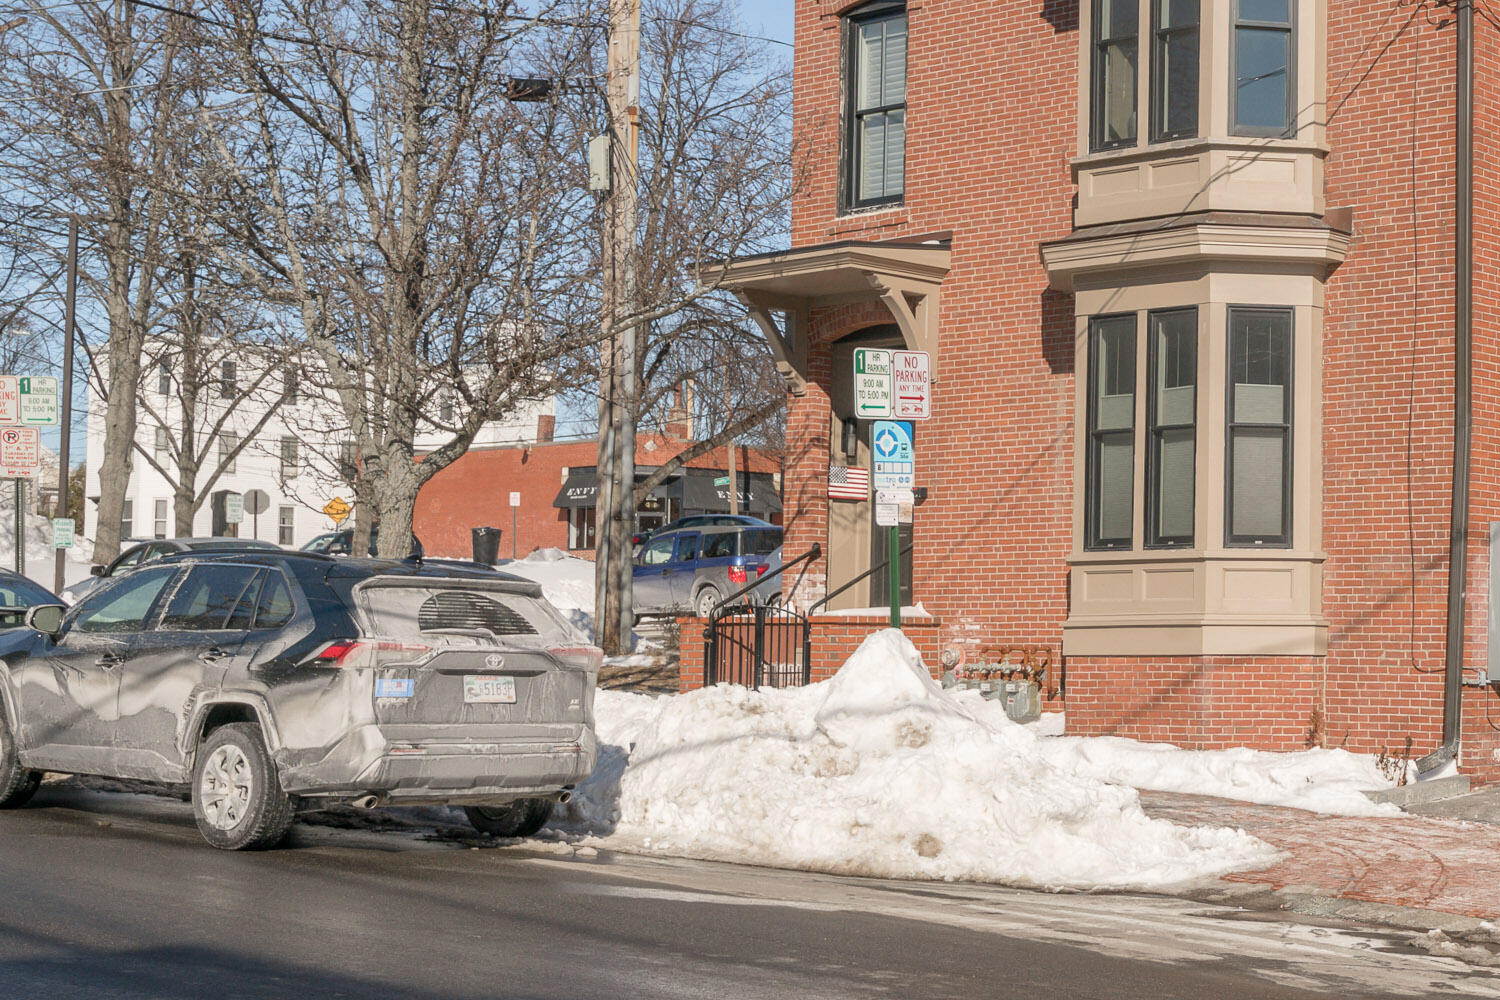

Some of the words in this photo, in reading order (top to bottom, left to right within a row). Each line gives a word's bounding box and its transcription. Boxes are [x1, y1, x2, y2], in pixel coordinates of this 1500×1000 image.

[859, 353, 863, 370] 1
[872, 353, 881, 361] HR
[904, 356, 918, 369] NO
[867, 364, 889, 373] PARKING
[895, 370, 927, 383] PARKING
[863, 379, 875, 388] 9:00
[876, 379, 883, 388] AM
[899, 384, 910, 392] ANY
[912, 385, 925, 393] TIME
[858, 390, 866, 399] TO
[867, 391, 879, 399] 5:00
[881, 391, 889, 399] PM
[566, 487, 598, 496] ENVY
